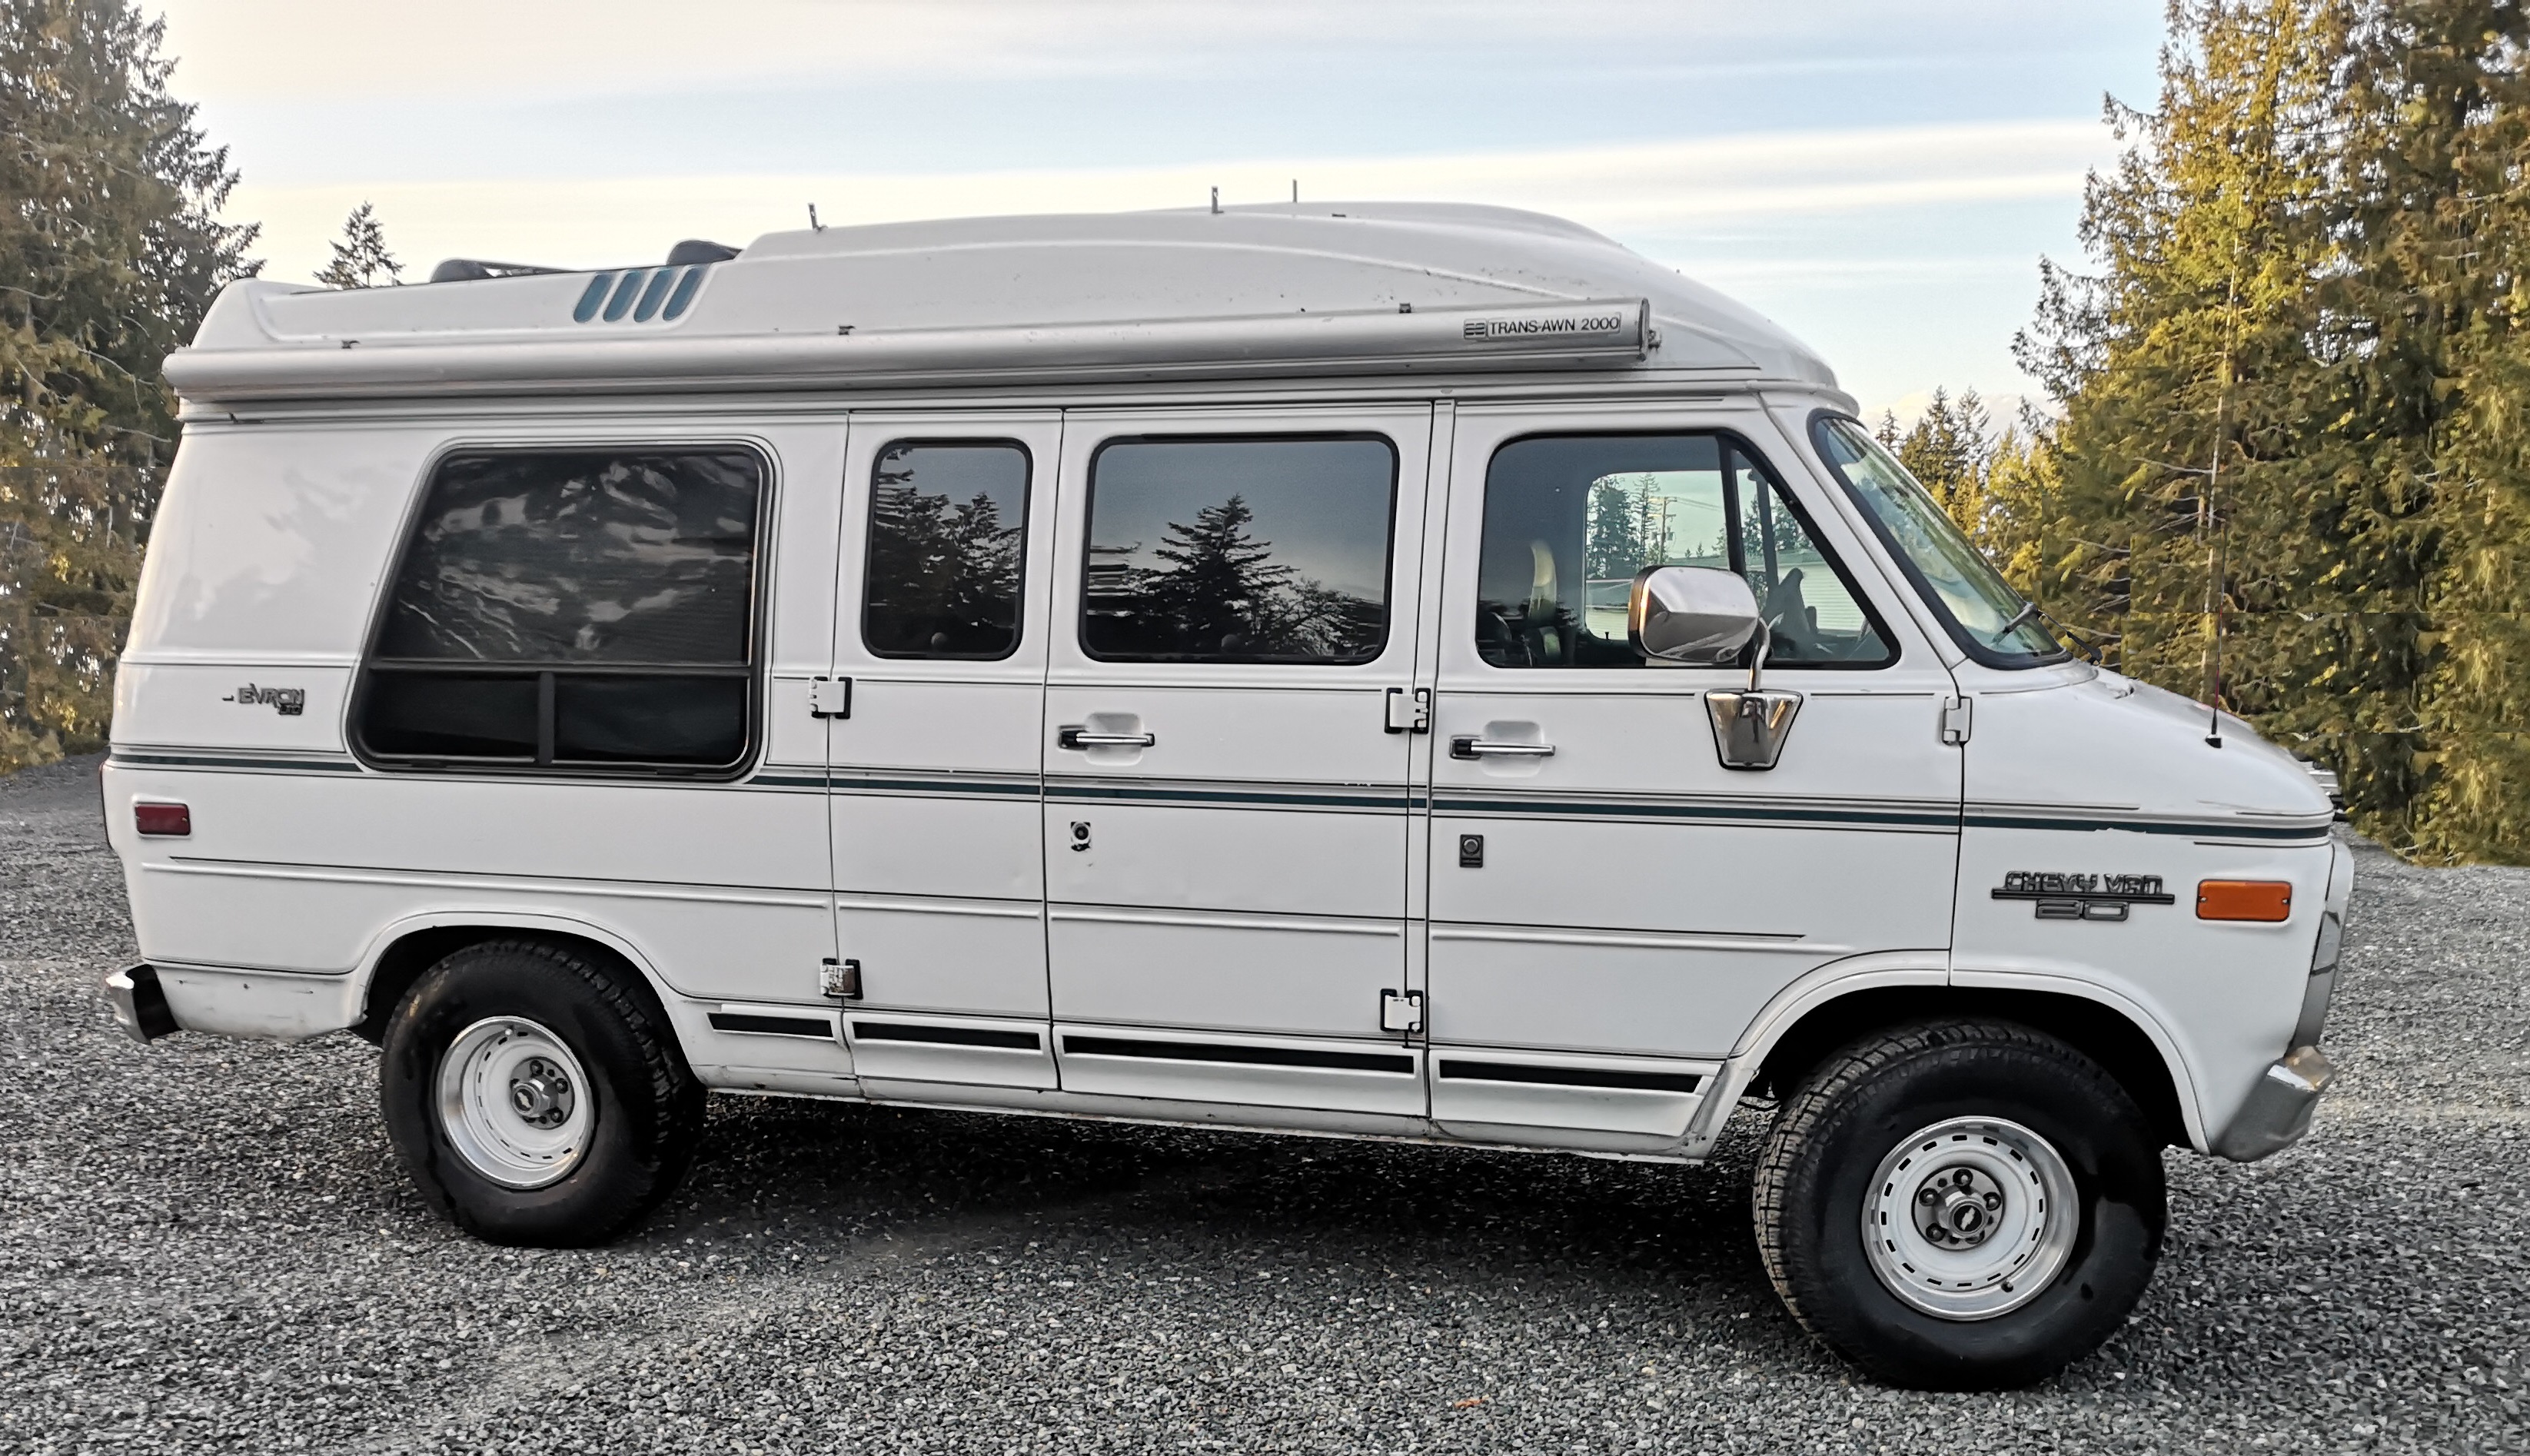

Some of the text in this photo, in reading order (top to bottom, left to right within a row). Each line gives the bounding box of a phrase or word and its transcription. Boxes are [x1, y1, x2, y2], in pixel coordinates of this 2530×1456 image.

[1489, 317, 1620, 335] TRANS-AWN 2000
[2005, 871, 2098, 893] CHEVY
